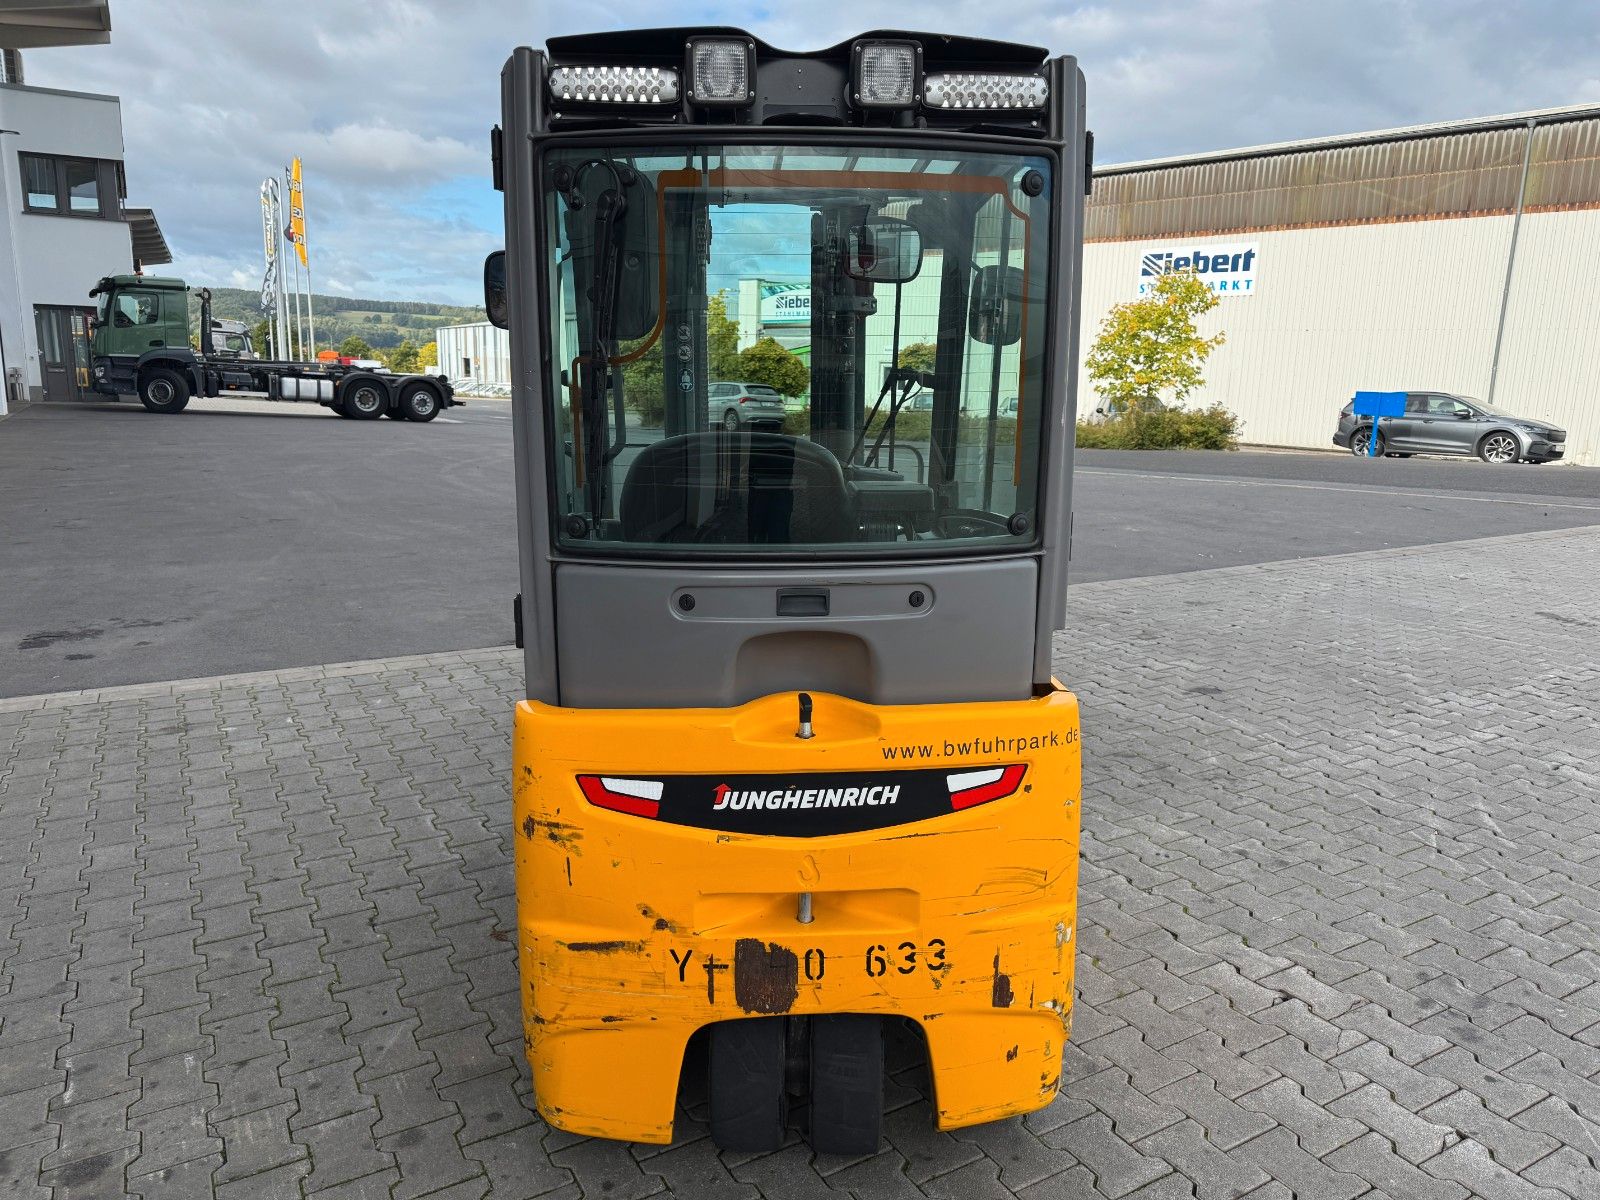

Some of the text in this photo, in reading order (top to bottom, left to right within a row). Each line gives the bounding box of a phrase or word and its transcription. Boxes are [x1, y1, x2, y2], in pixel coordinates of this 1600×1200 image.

[1141, 248, 1256, 276] Siebert
[882, 727, 1078, 760] www.bwfuhrpark.de
[712, 783, 901, 811] JUNGHEINRICH
[866, 938, 947, 978] 633
